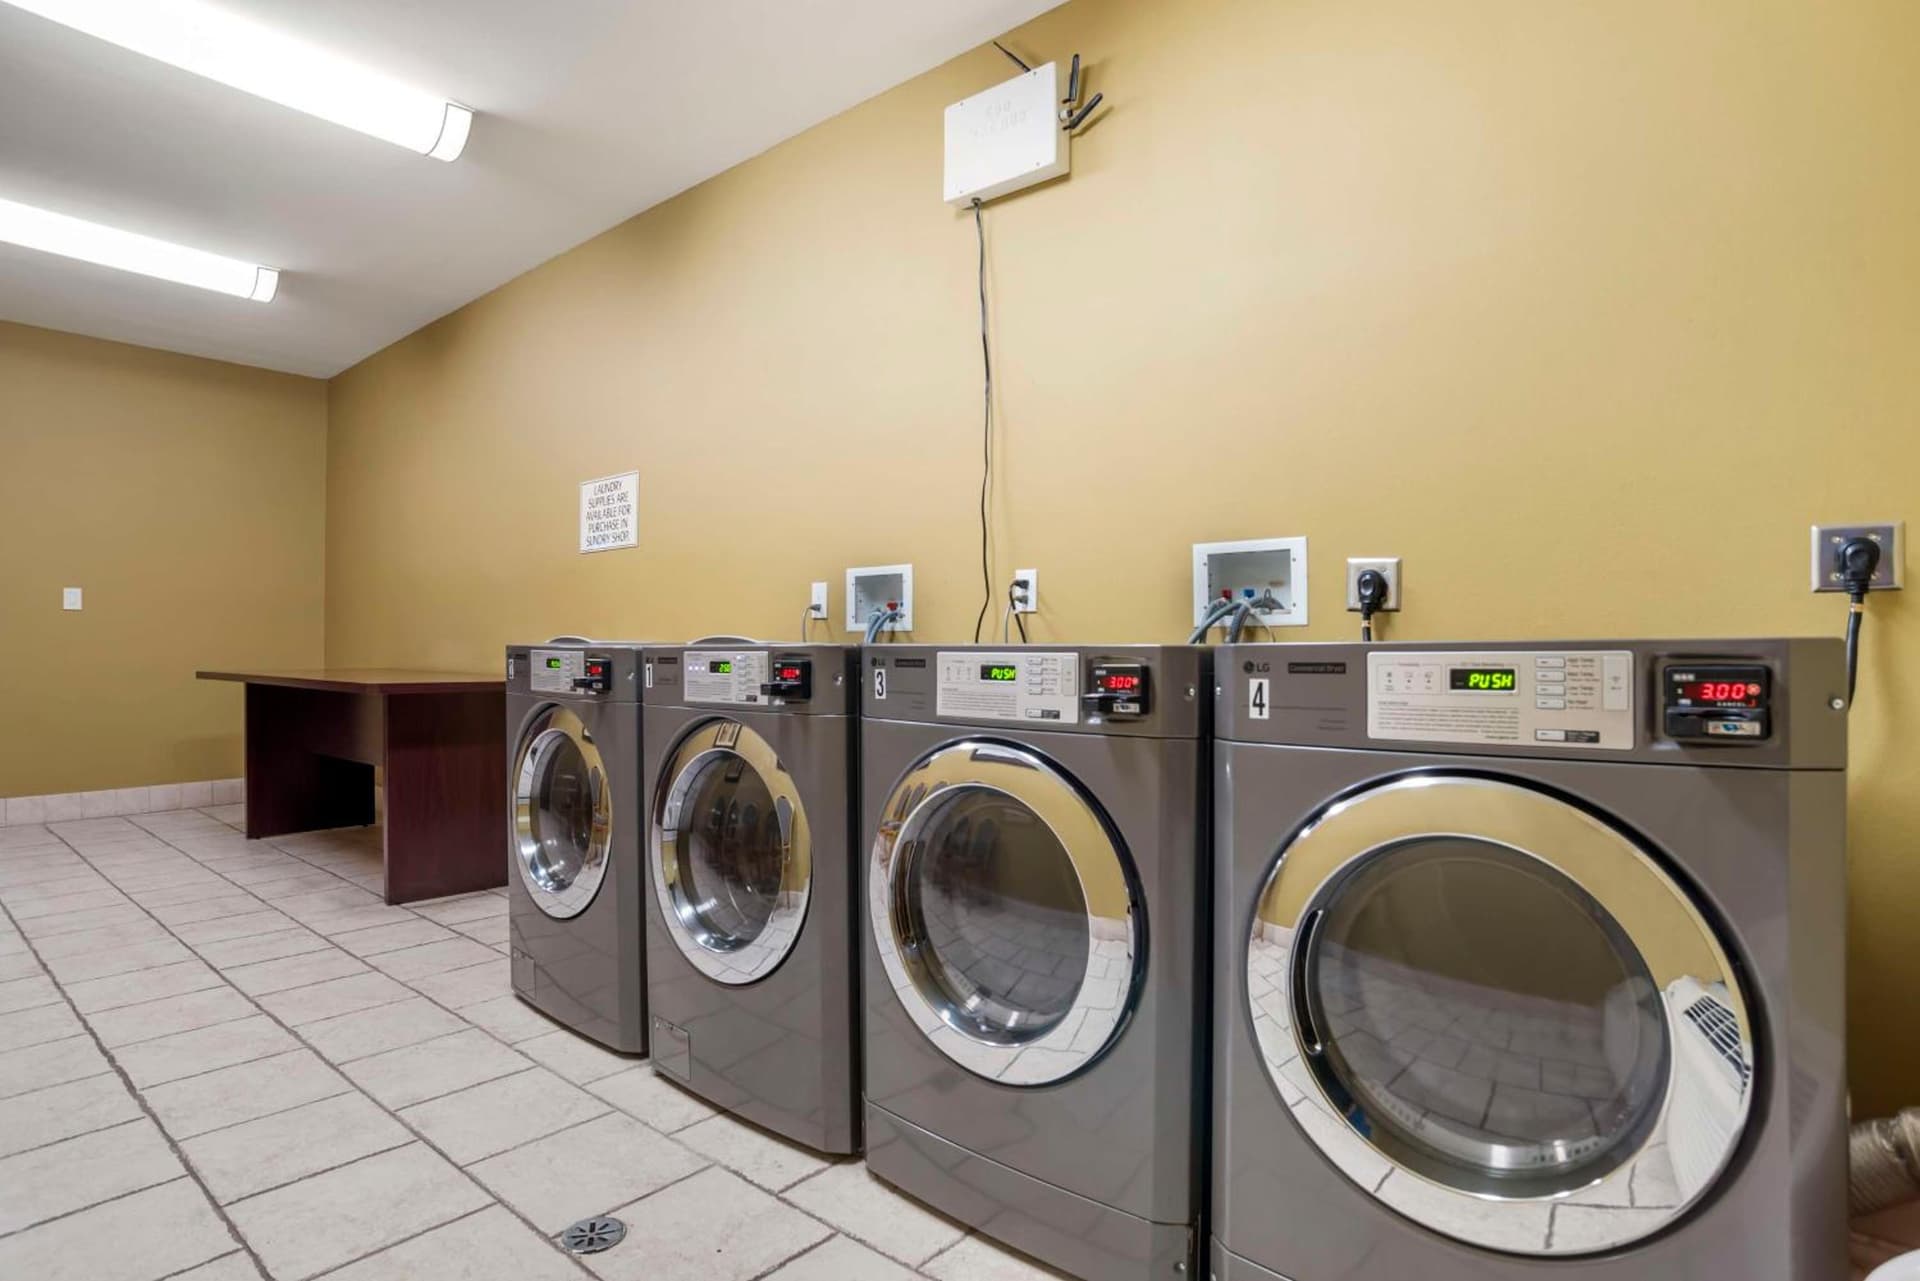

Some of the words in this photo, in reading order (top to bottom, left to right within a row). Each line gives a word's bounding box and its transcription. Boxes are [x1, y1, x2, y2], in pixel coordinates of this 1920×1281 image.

[593, 480, 623, 496] LAUNDRY
[588, 493, 616, 509] SUPPLIES
[617, 491, 630, 504] ARE
[586, 506, 617, 521] AVAILABLE
[618, 504, 632, 517] FOR
[587, 519, 620, 534] PURCHASE
[620, 517, 629, 529] IN
[586, 533, 611, 547] SUNDRY
[991, 667, 1016, 680] PUSH
[1468, 672, 1513, 689] PUSH
[875, 671, 885, 697] 3
[1252, 681, 1266, 716] 4
